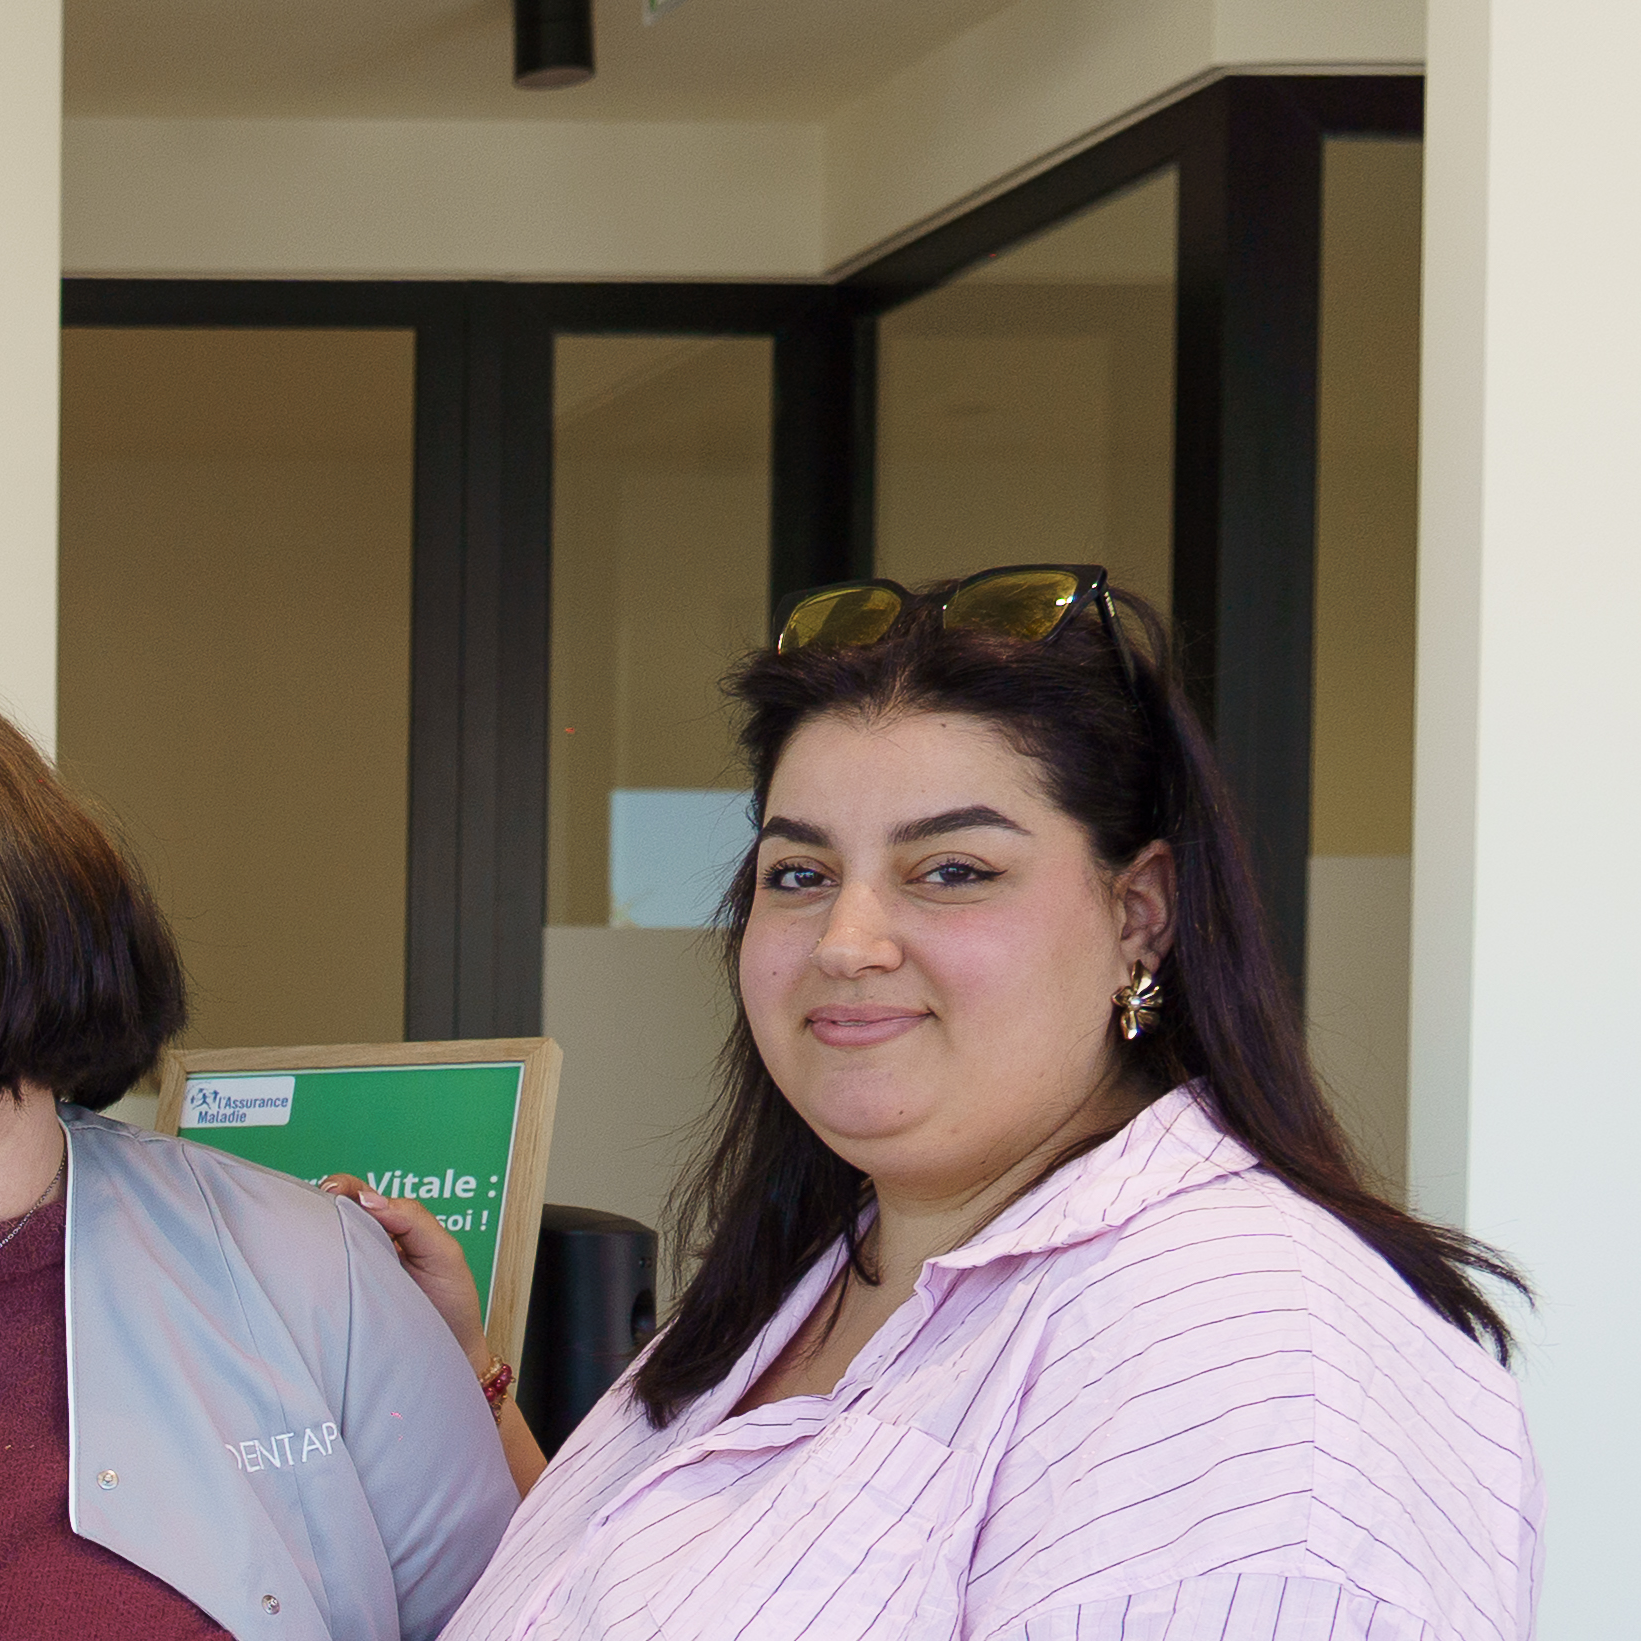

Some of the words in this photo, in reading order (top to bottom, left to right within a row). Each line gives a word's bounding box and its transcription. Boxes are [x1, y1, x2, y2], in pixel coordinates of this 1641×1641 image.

[217, 1096, 288, 1110] l'Assurance
[197, 1110, 247, 1125] Maladie
[367, 1169, 477, 1199] Vitale
